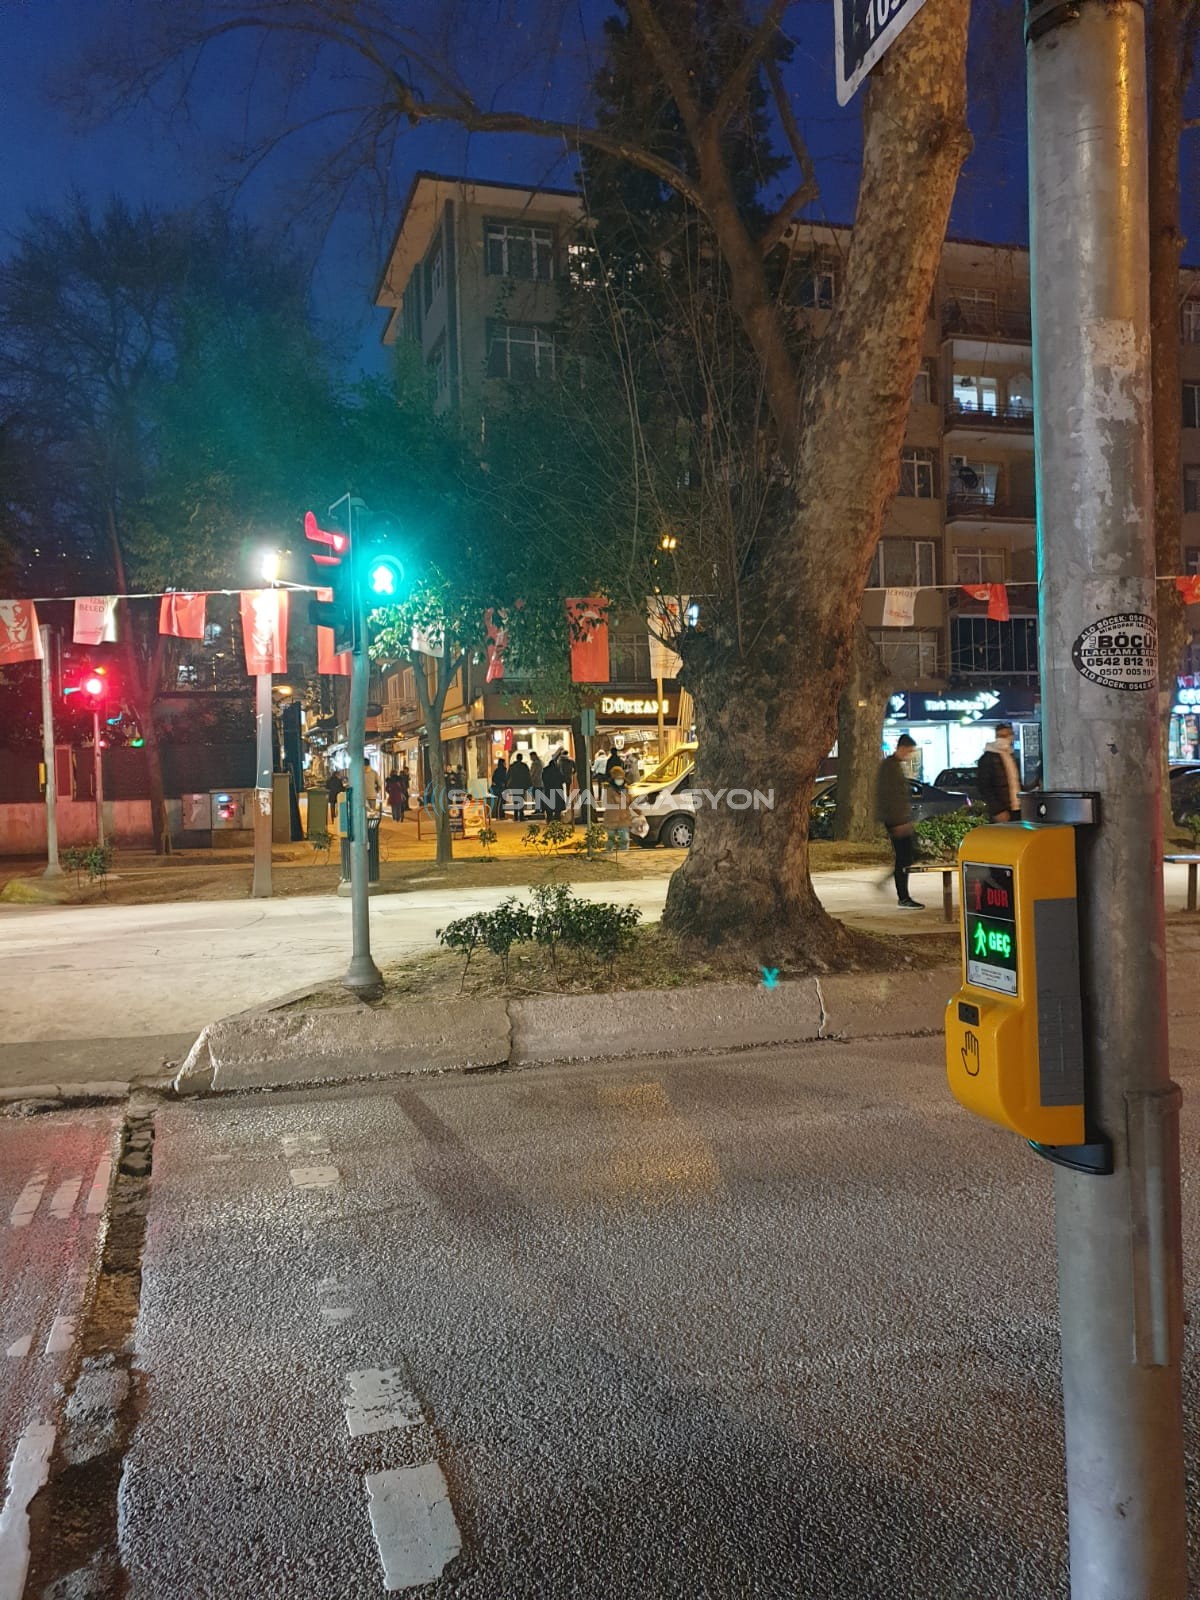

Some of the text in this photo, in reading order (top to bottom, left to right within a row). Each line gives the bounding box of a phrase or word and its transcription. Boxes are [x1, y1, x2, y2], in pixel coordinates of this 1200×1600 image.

[866, 0, 901, 40] 10
[1081, 627, 1096, 641] ALO
[1087, 657, 1120, 667] 0542
[1124, 657, 1144, 667] 812
[1080, 667, 1096, 680] ALO
[986, 887, 1009, 908] DUR
[988, 931, 1012, 958] GEÇ
